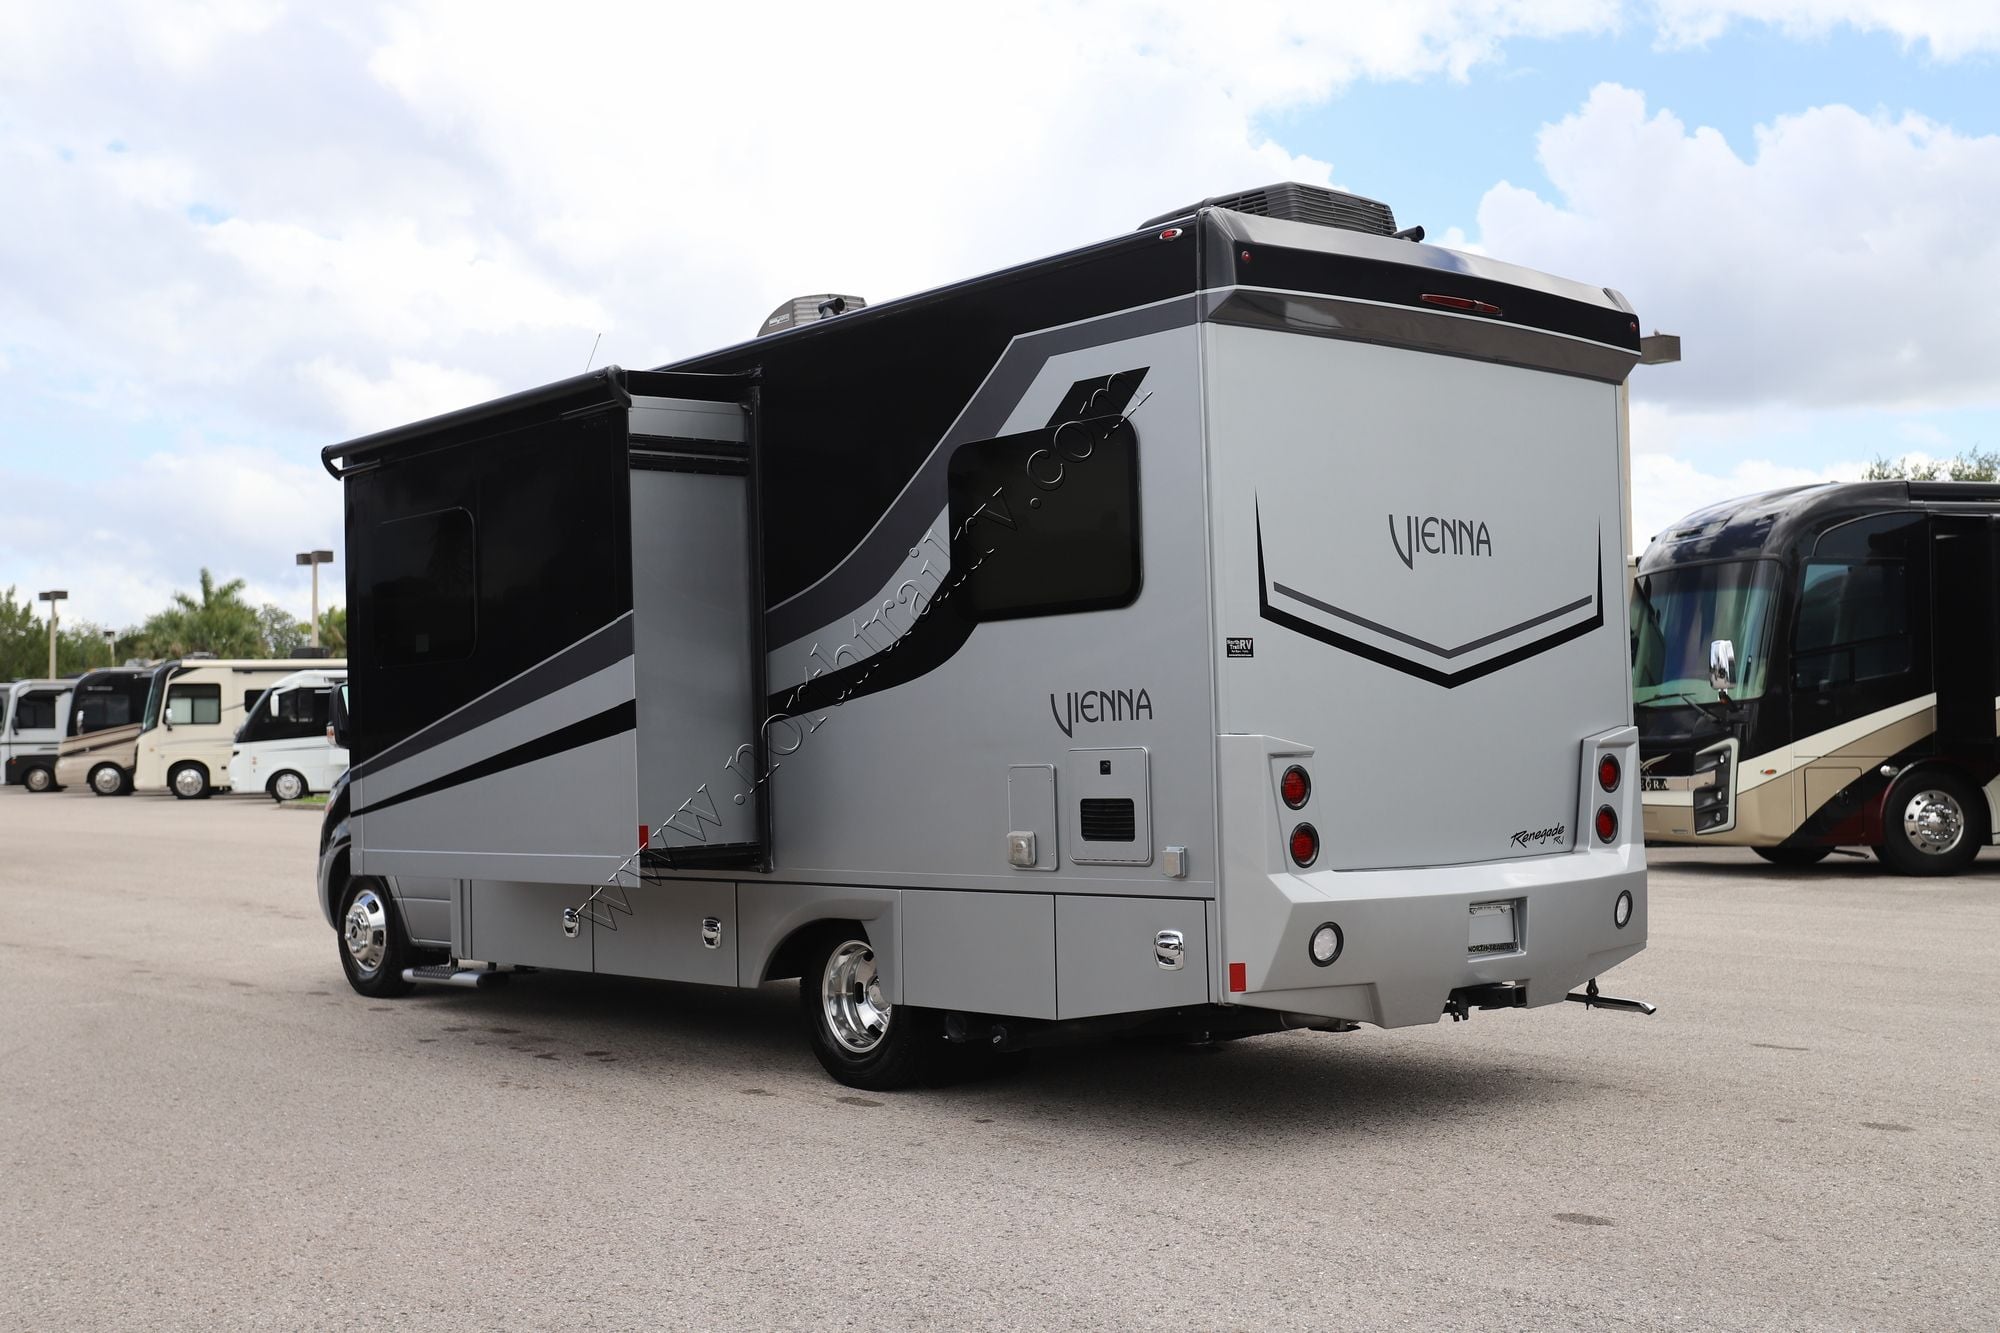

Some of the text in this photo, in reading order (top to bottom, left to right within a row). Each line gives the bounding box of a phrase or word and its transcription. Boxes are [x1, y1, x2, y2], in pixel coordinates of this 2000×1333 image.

[1388, 514, 1492, 570] VIENNA
[1240, 640, 1252, 649] RV
[1050, 688, 1153, 738] VIENNA
[1510, 822, 1565, 848] Renegade
